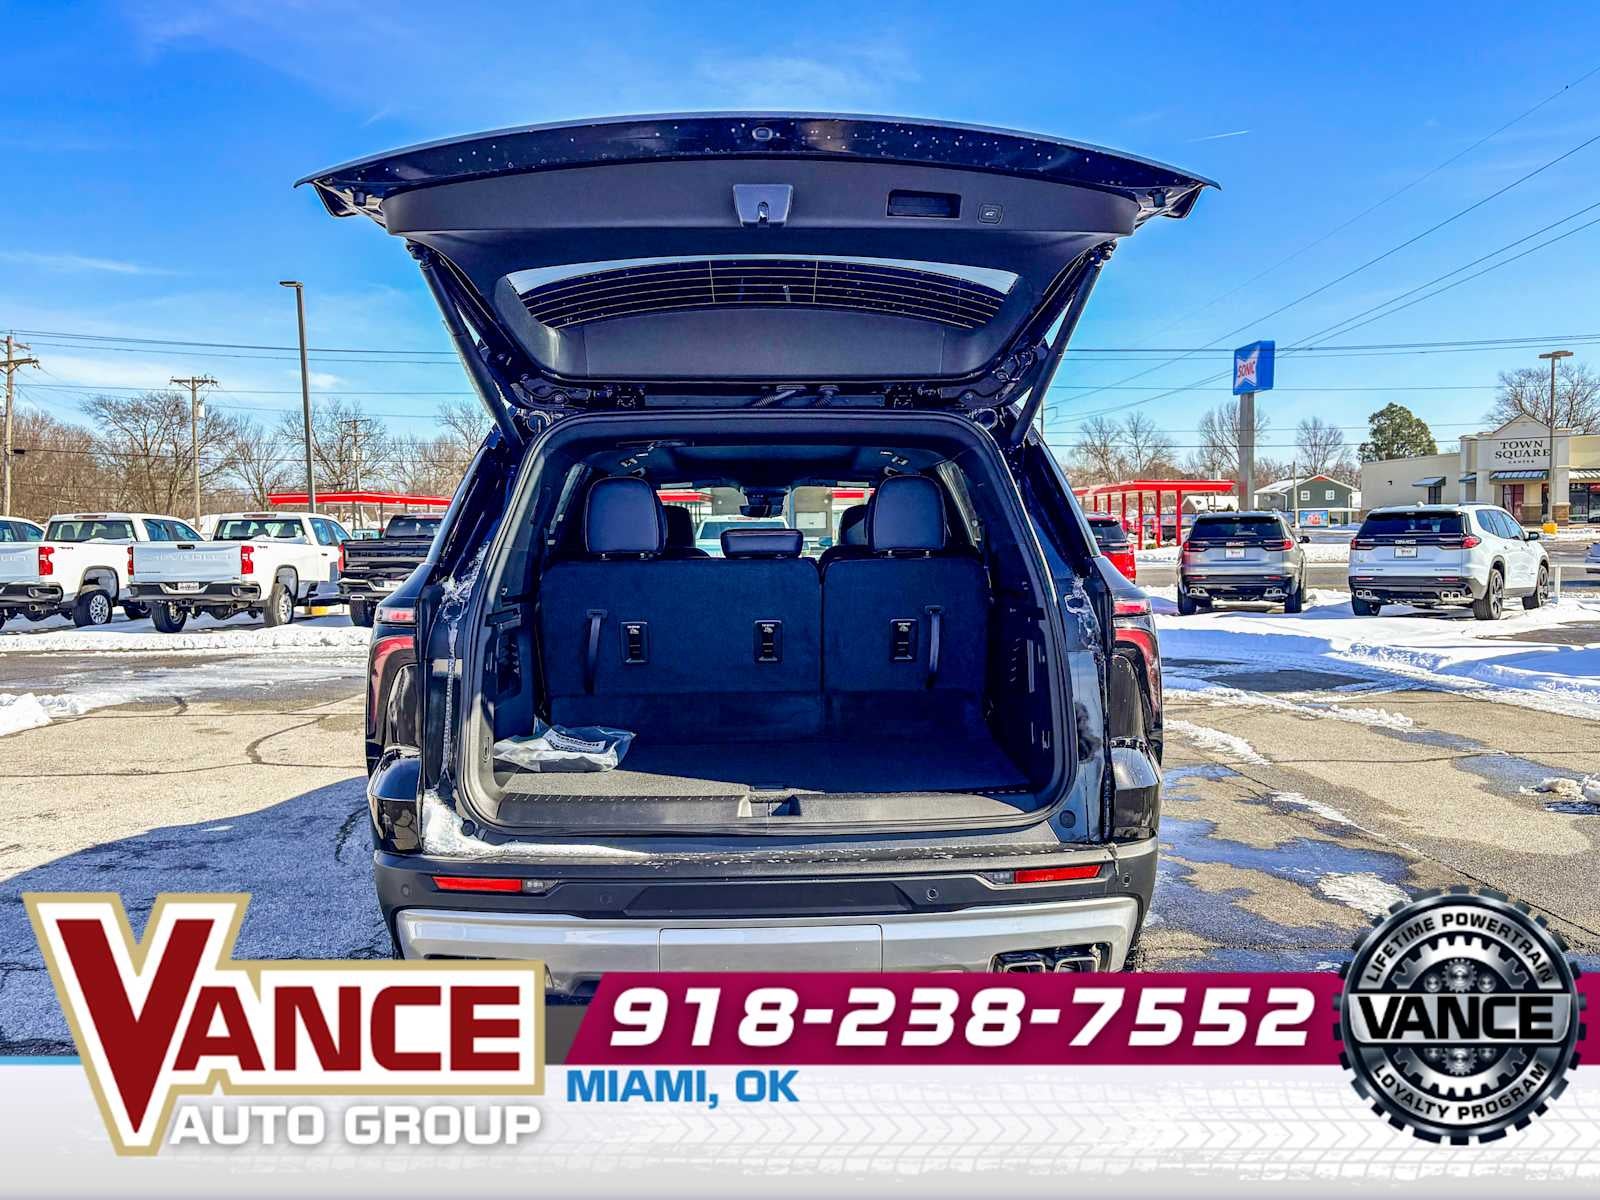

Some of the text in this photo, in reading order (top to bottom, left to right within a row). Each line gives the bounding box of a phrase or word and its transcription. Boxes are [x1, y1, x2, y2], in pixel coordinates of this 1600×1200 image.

[1238, 360, 1256, 378] SONIC
[1500, 440, 1543, 449] TOWN
[1495, 449, 1551, 459] SQUARE
